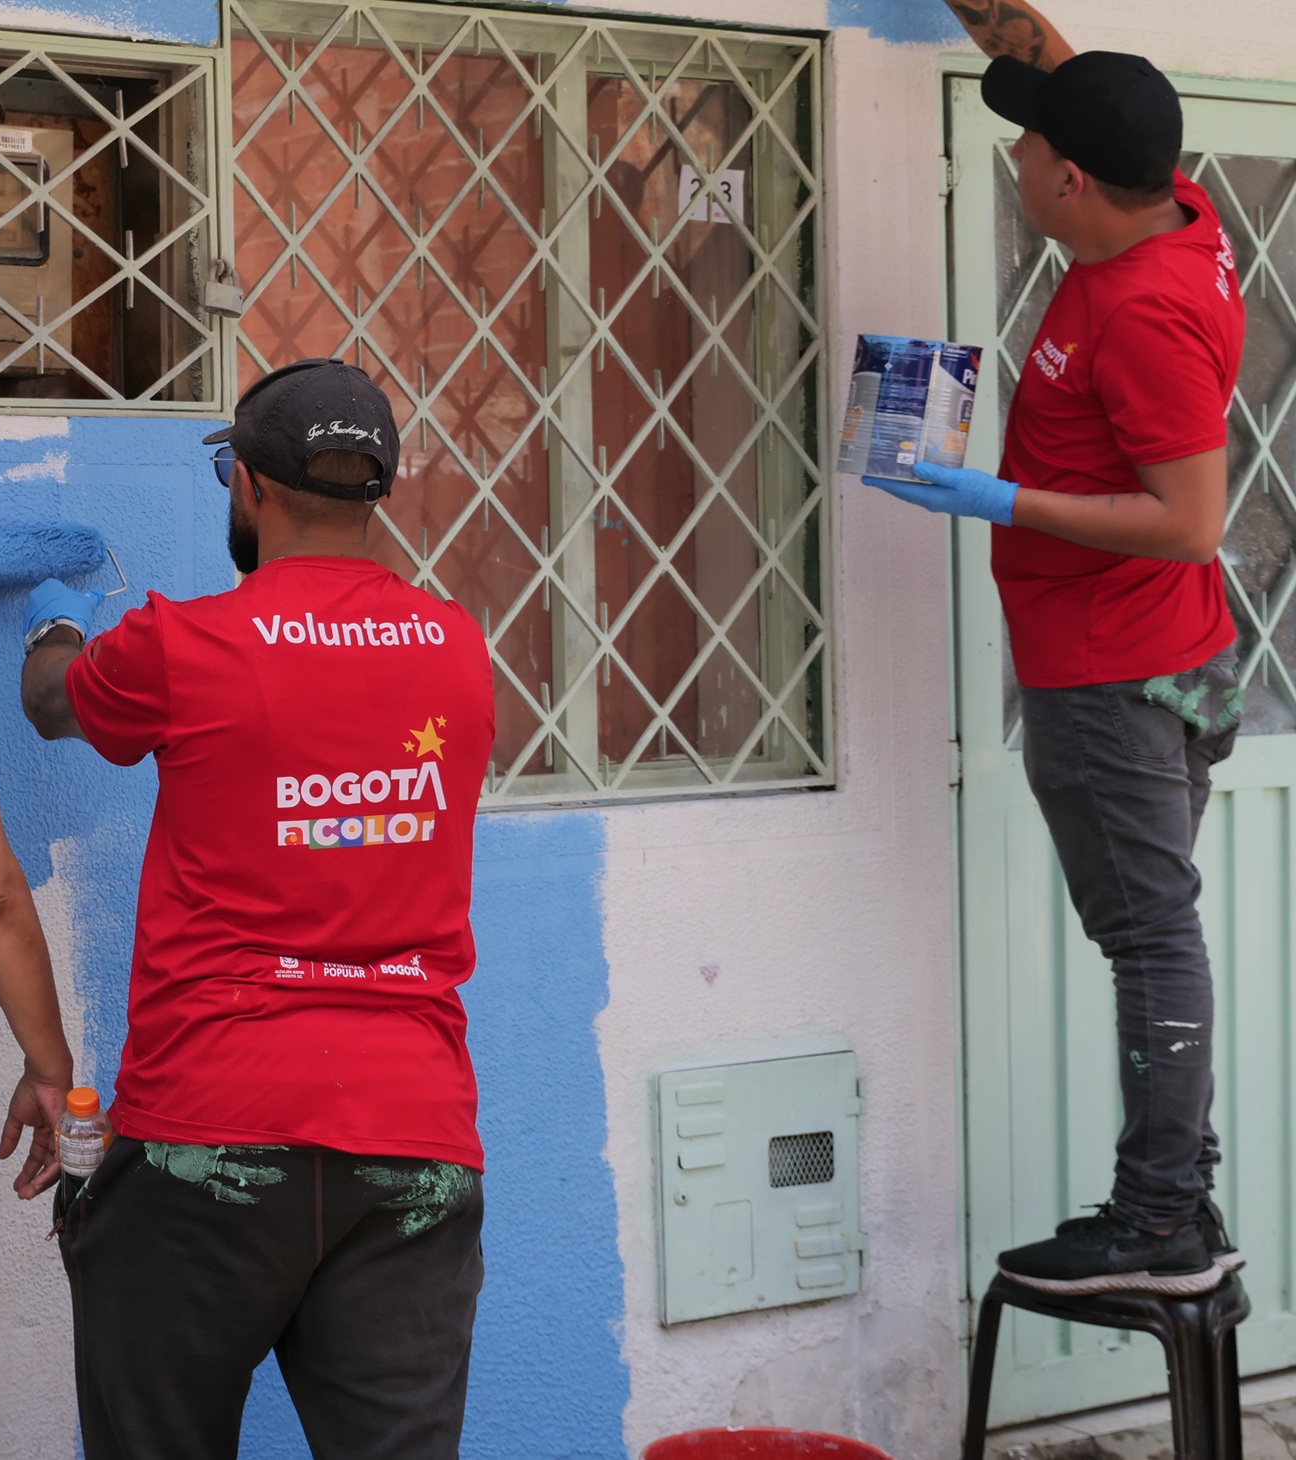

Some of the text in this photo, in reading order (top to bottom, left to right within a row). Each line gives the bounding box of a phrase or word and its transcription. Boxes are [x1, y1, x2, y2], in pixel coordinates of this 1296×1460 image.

[307, 423, 325, 441] Too
[327, 420, 368, 440] Fucking
[252, 612, 445, 646] Voluntario
[323, 967, 367, 979] POPULAR
